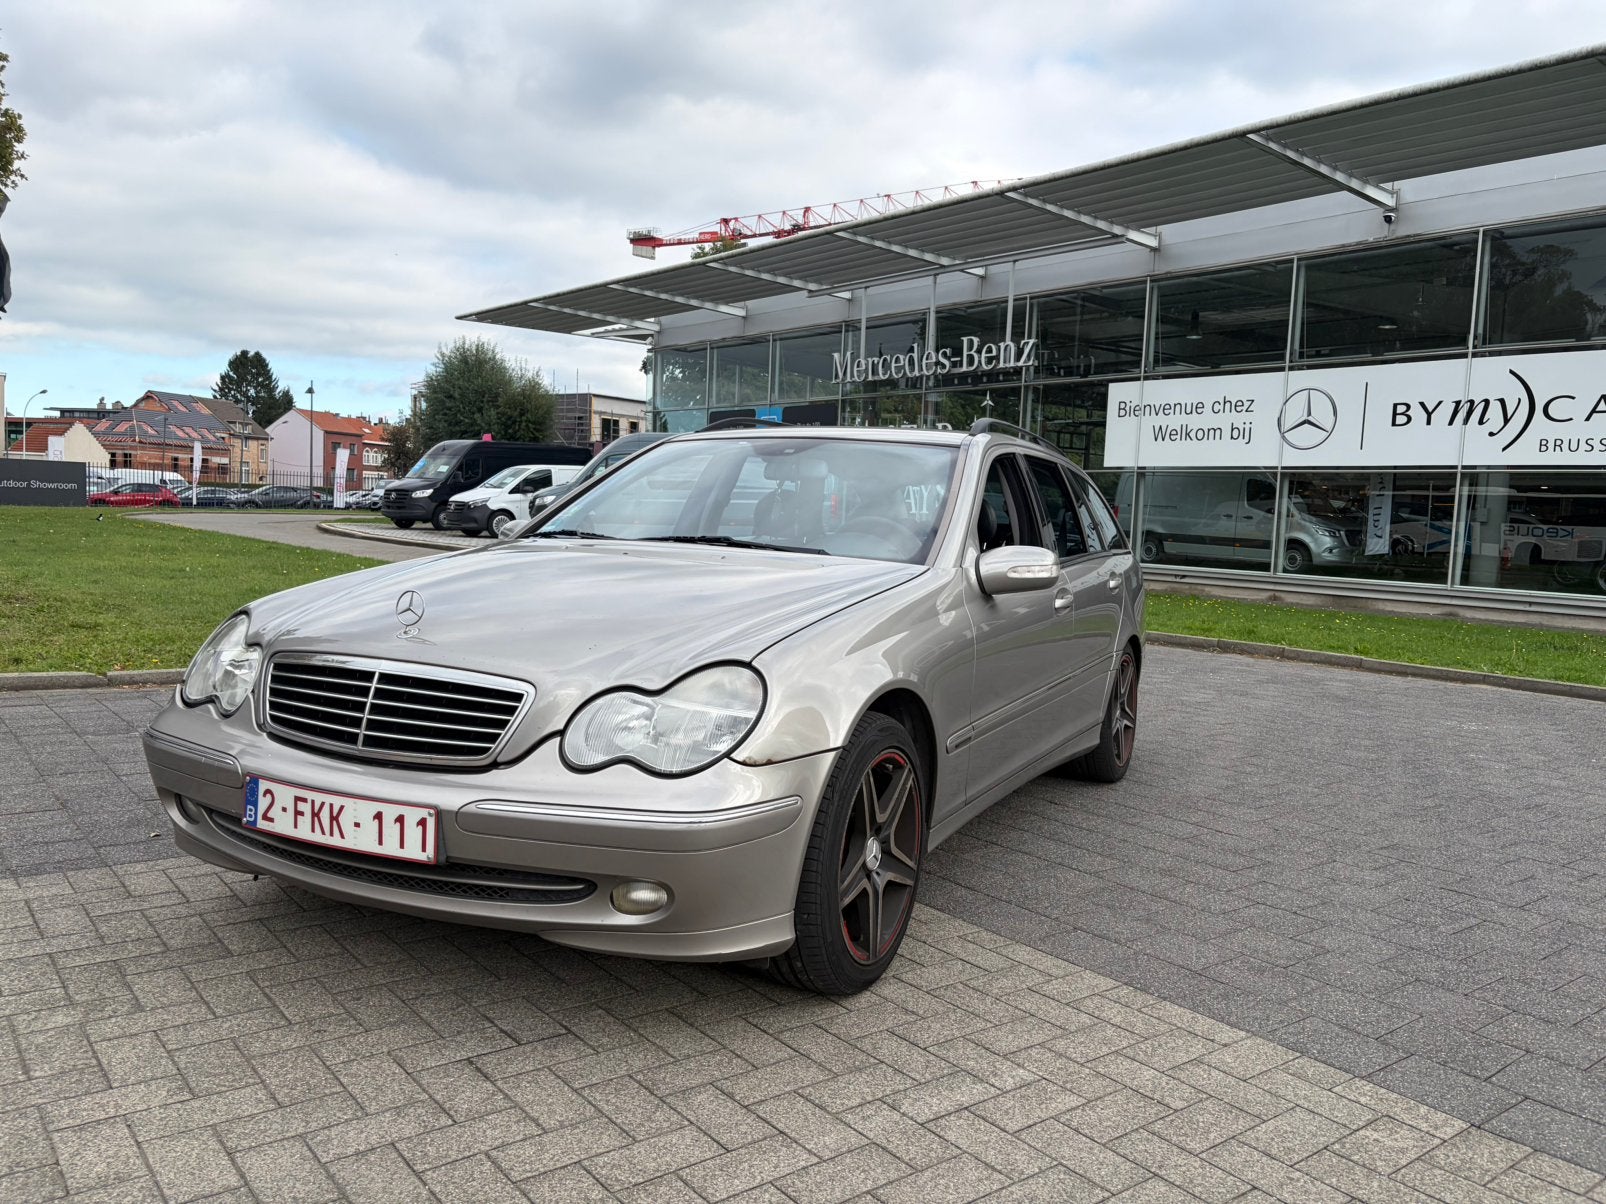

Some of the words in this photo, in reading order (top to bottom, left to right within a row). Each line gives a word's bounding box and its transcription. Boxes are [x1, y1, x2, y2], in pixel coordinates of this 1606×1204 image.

[831, 336, 1038, 384] Mercedes-Benz
[1117, 400, 1205, 418] Bienvenue
[1211, 396, 1255, 414] chez
[1152, 423, 1223, 442] Welkom
[1230, 422, 1253, 445] bij
[30, 480, 78, 490] Showroom
[246, 805, 255, 822] B
[262, 788, 428, 853] 2-FKK-111
